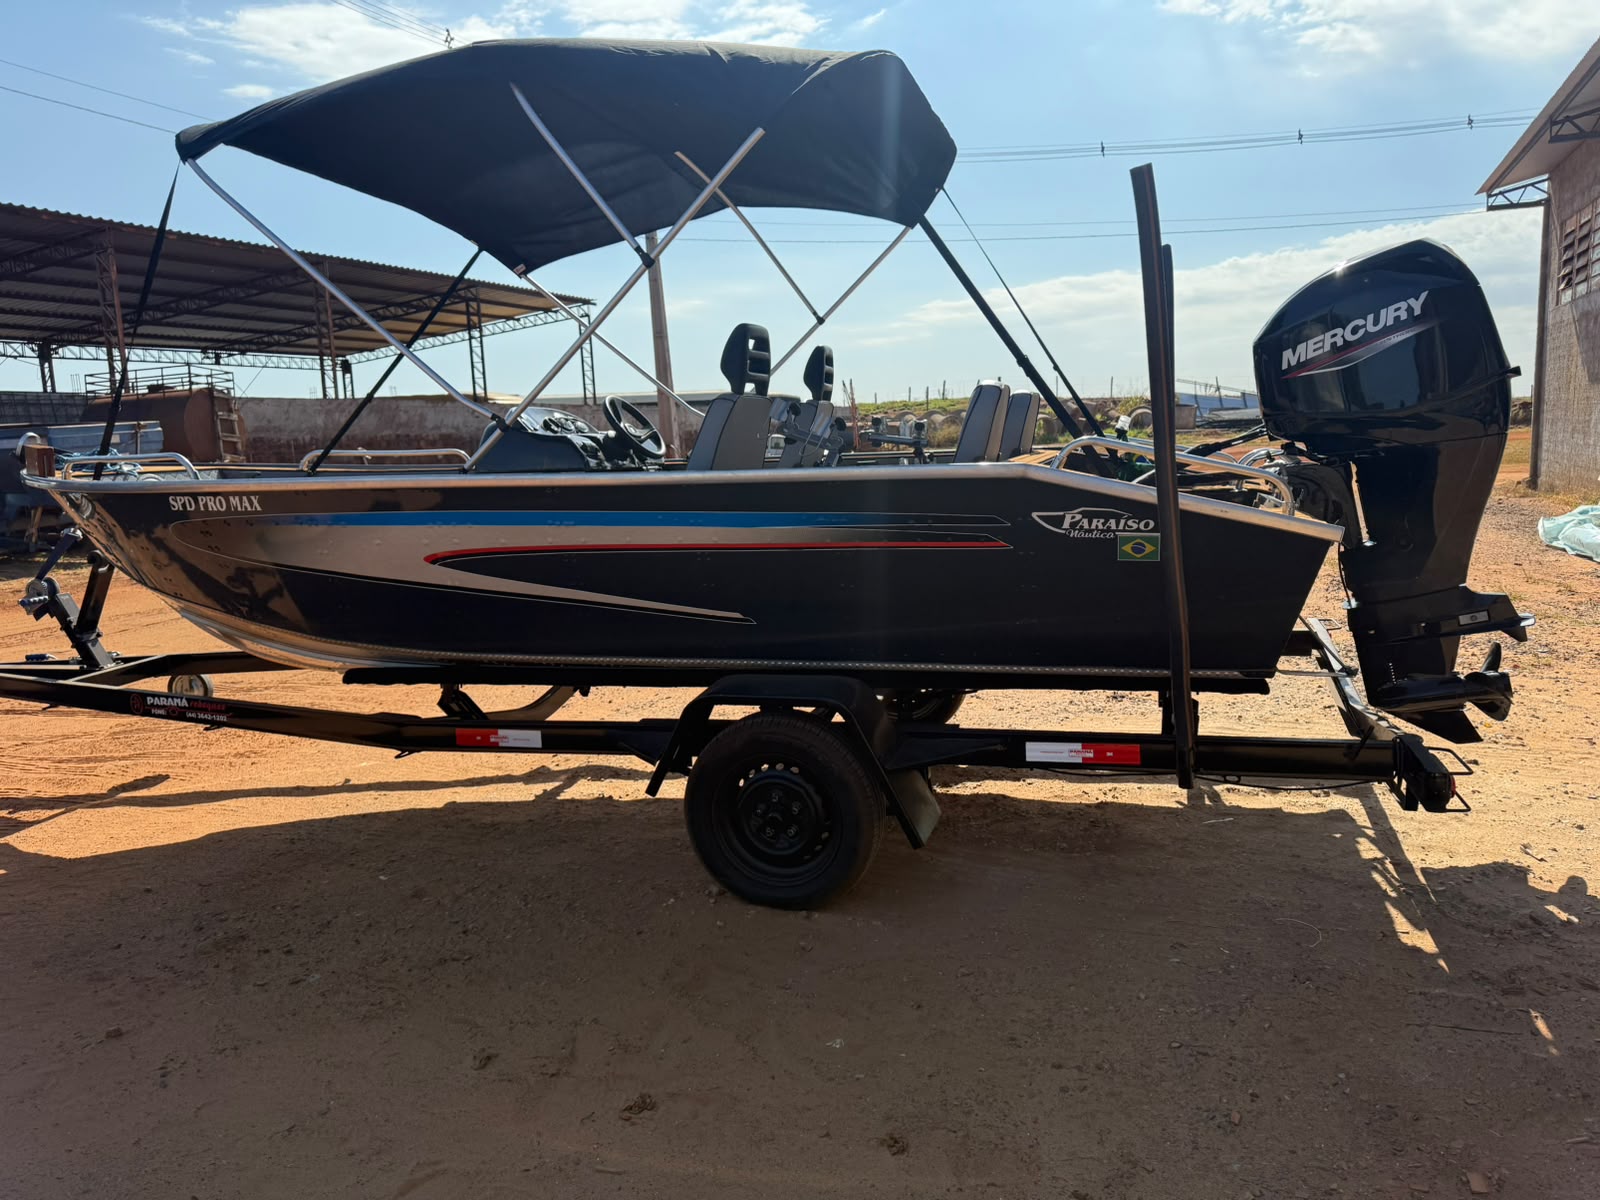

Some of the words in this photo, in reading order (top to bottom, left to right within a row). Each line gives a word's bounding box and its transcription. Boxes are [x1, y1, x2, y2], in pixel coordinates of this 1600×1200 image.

[1281, 290, 1429, 371] MERCURY
[168, 496, 196, 511] SPD
[197, 496, 227, 511] PRO
[229, 496, 262, 511] MAX
[1065, 529, 1115, 539] Náutica
[146, 696, 189, 707] PARANÁ
